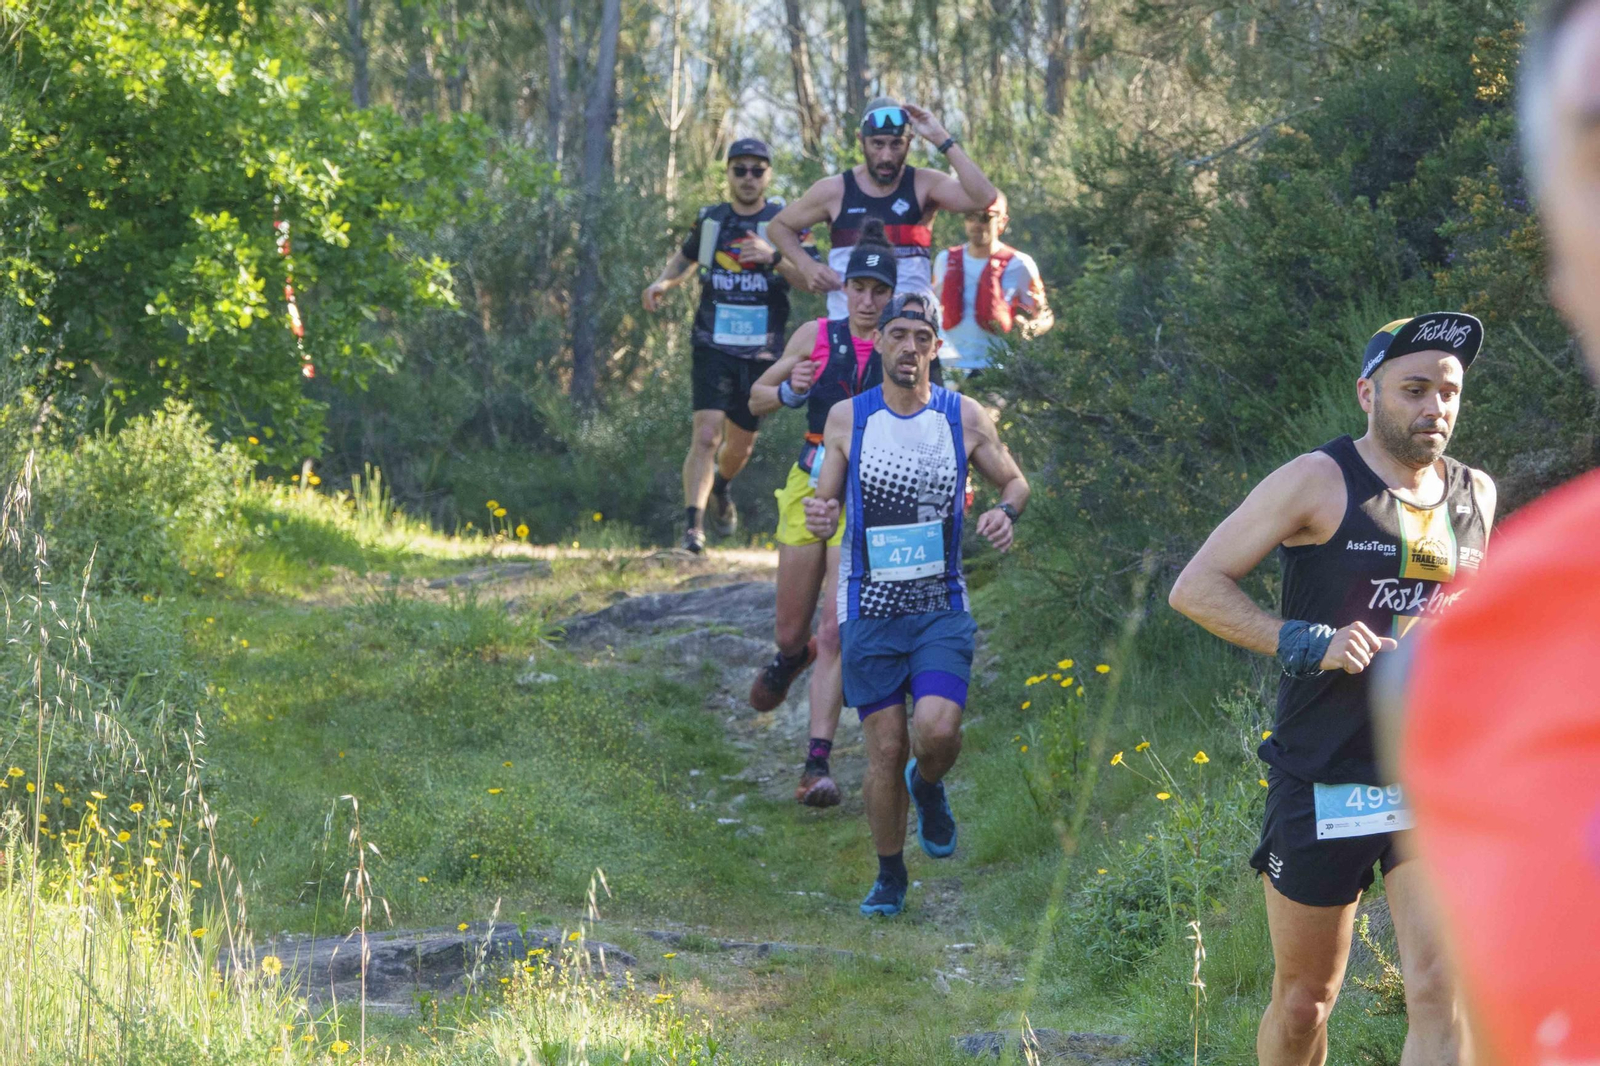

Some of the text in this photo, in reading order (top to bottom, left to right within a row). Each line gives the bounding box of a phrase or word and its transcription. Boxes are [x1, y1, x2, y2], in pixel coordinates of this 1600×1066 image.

[889, 545, 927, 565] 474
[1346, 540, 1397, 552] AssisTens
[1345, 783, 1403, 811] 499
